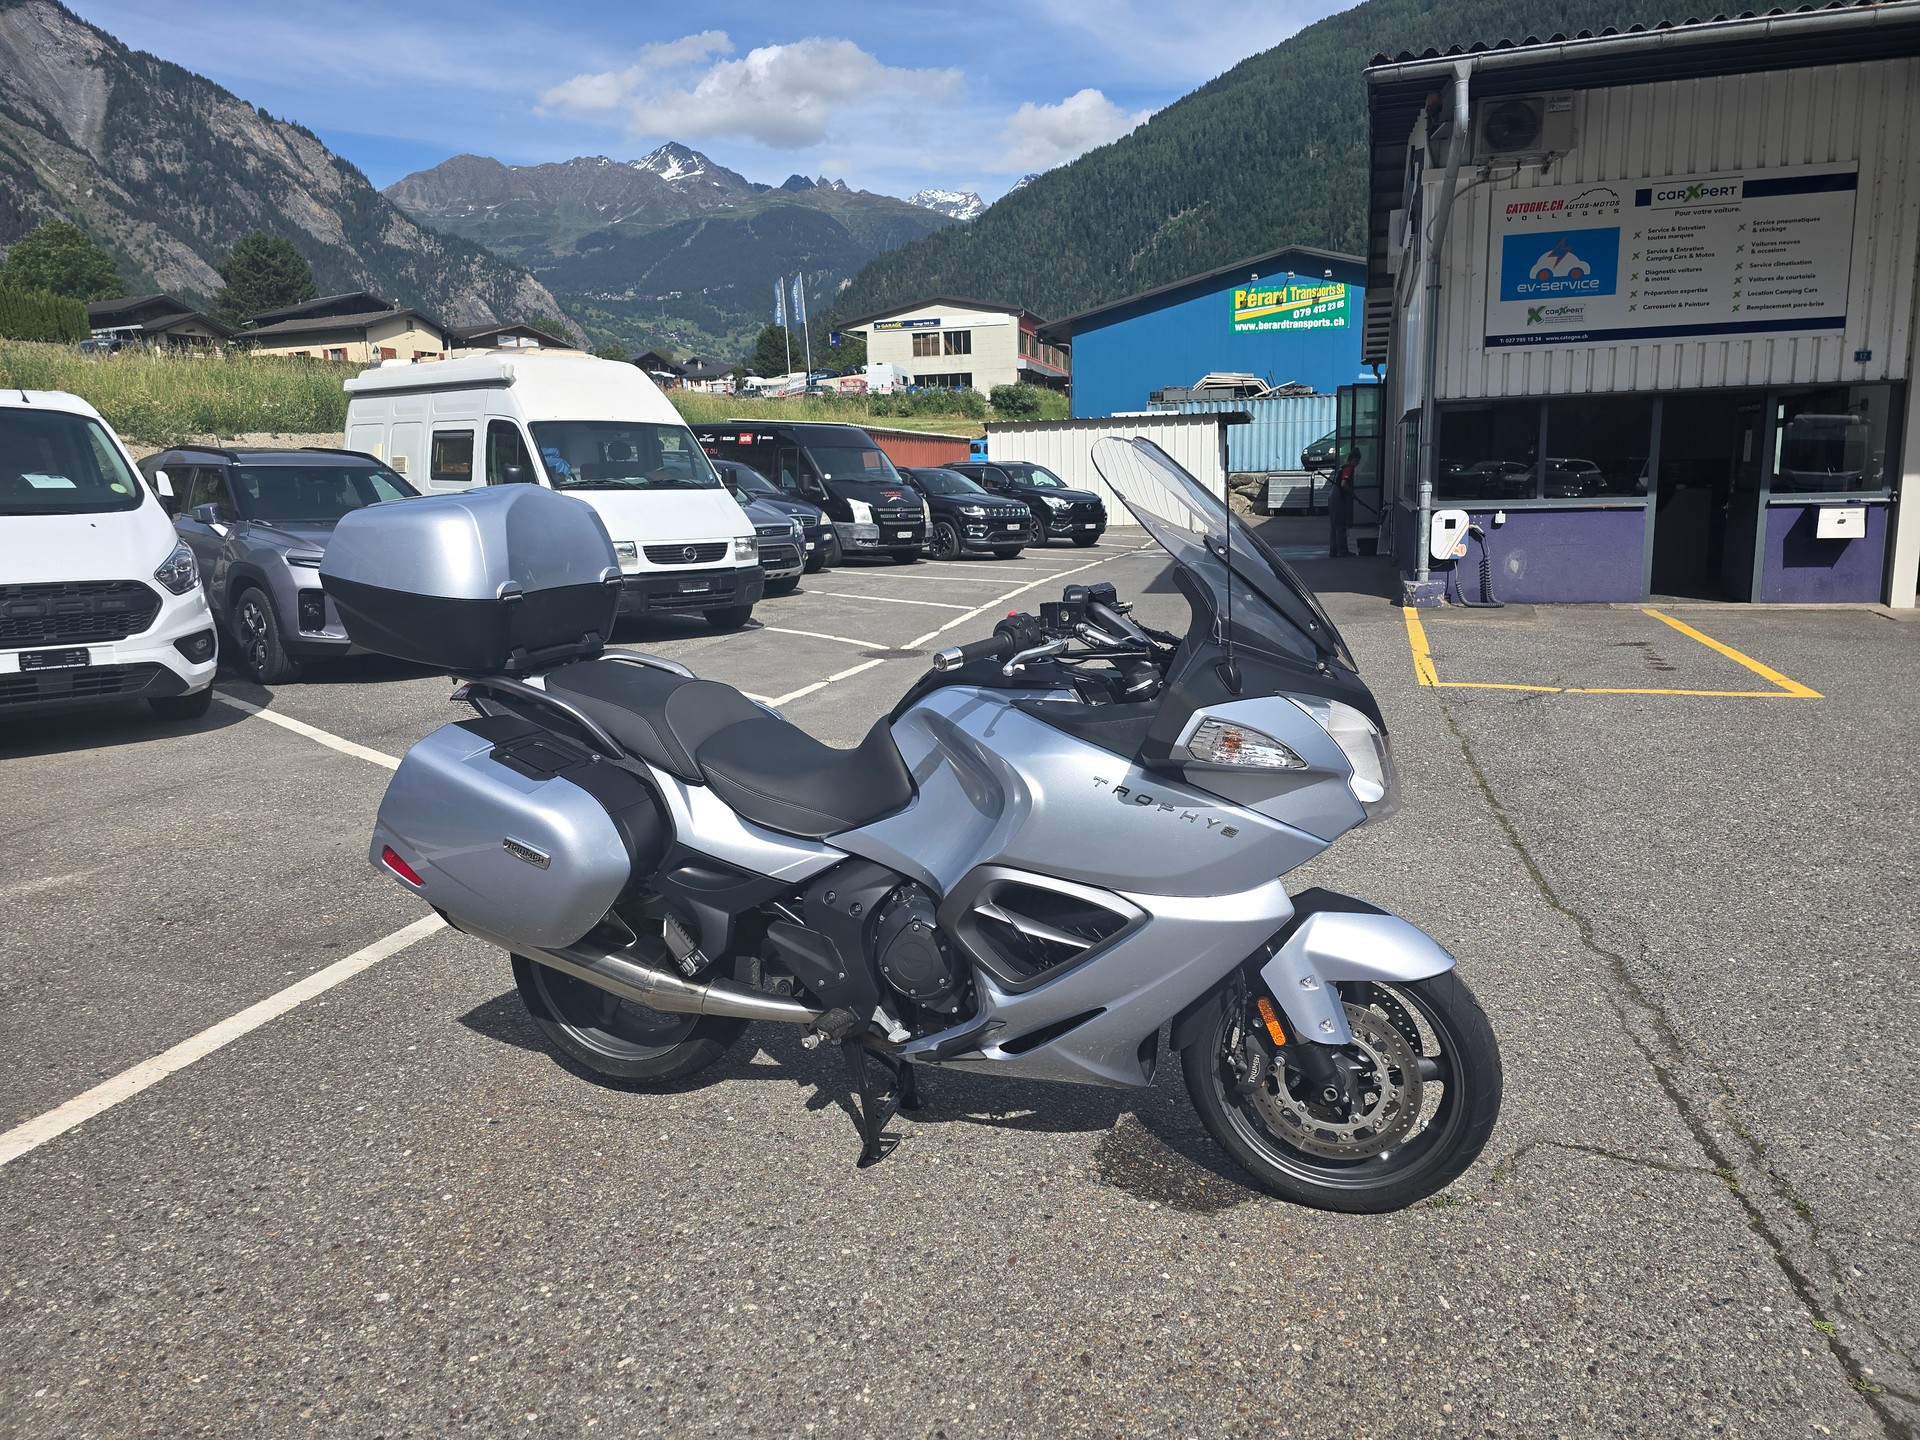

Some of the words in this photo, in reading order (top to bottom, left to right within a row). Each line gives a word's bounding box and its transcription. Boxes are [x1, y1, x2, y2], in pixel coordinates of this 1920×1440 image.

[1505, 199, 1565, 215] CATOGNE.CH
[1564, 200, 1621, 210] AUTOS-MOTOS
[1674, 209, 1691, 217] Pour
[1713, 206, 1741, 214] voiture.
[1776, 216, 1820, 225] pneumatiques
[1677, 224, 1706, 232] Entretien
[1676, 245, 1704, 253] Entretien
[1773, 259, 1812, 267] climatisation
[1645, 268, 1676, 276] Diagnostic
[1336, 282, 1345, 294] SA
[1516, 279, 1600, 293] ev-service
[1643, 289, 1678, 297] Préparation
[1680, 287, 1708, 295] expertise
[1747, 289, 1774, 297] Location
[1774, 287, 1802, 295] Camping
[1293, 308, 1311, 319] 079
[1313, 304, 1326, 315] 412
[1327, 302, 1336, 311] 23
[1746, 302, 1792, 311] Remplacement
[1792, 301, 1825, 309] pare-brise
[1235, 316, 1345, 331] www.berardtransports.ch
[1545, 333, 1589, 341] www.catogne.ch
[1093, 775, 1221, 829] TROPHY
[506, 840, 545, 864] TRIUMPH
[1247, 1053, 1261, 1083] TRIUMPH
